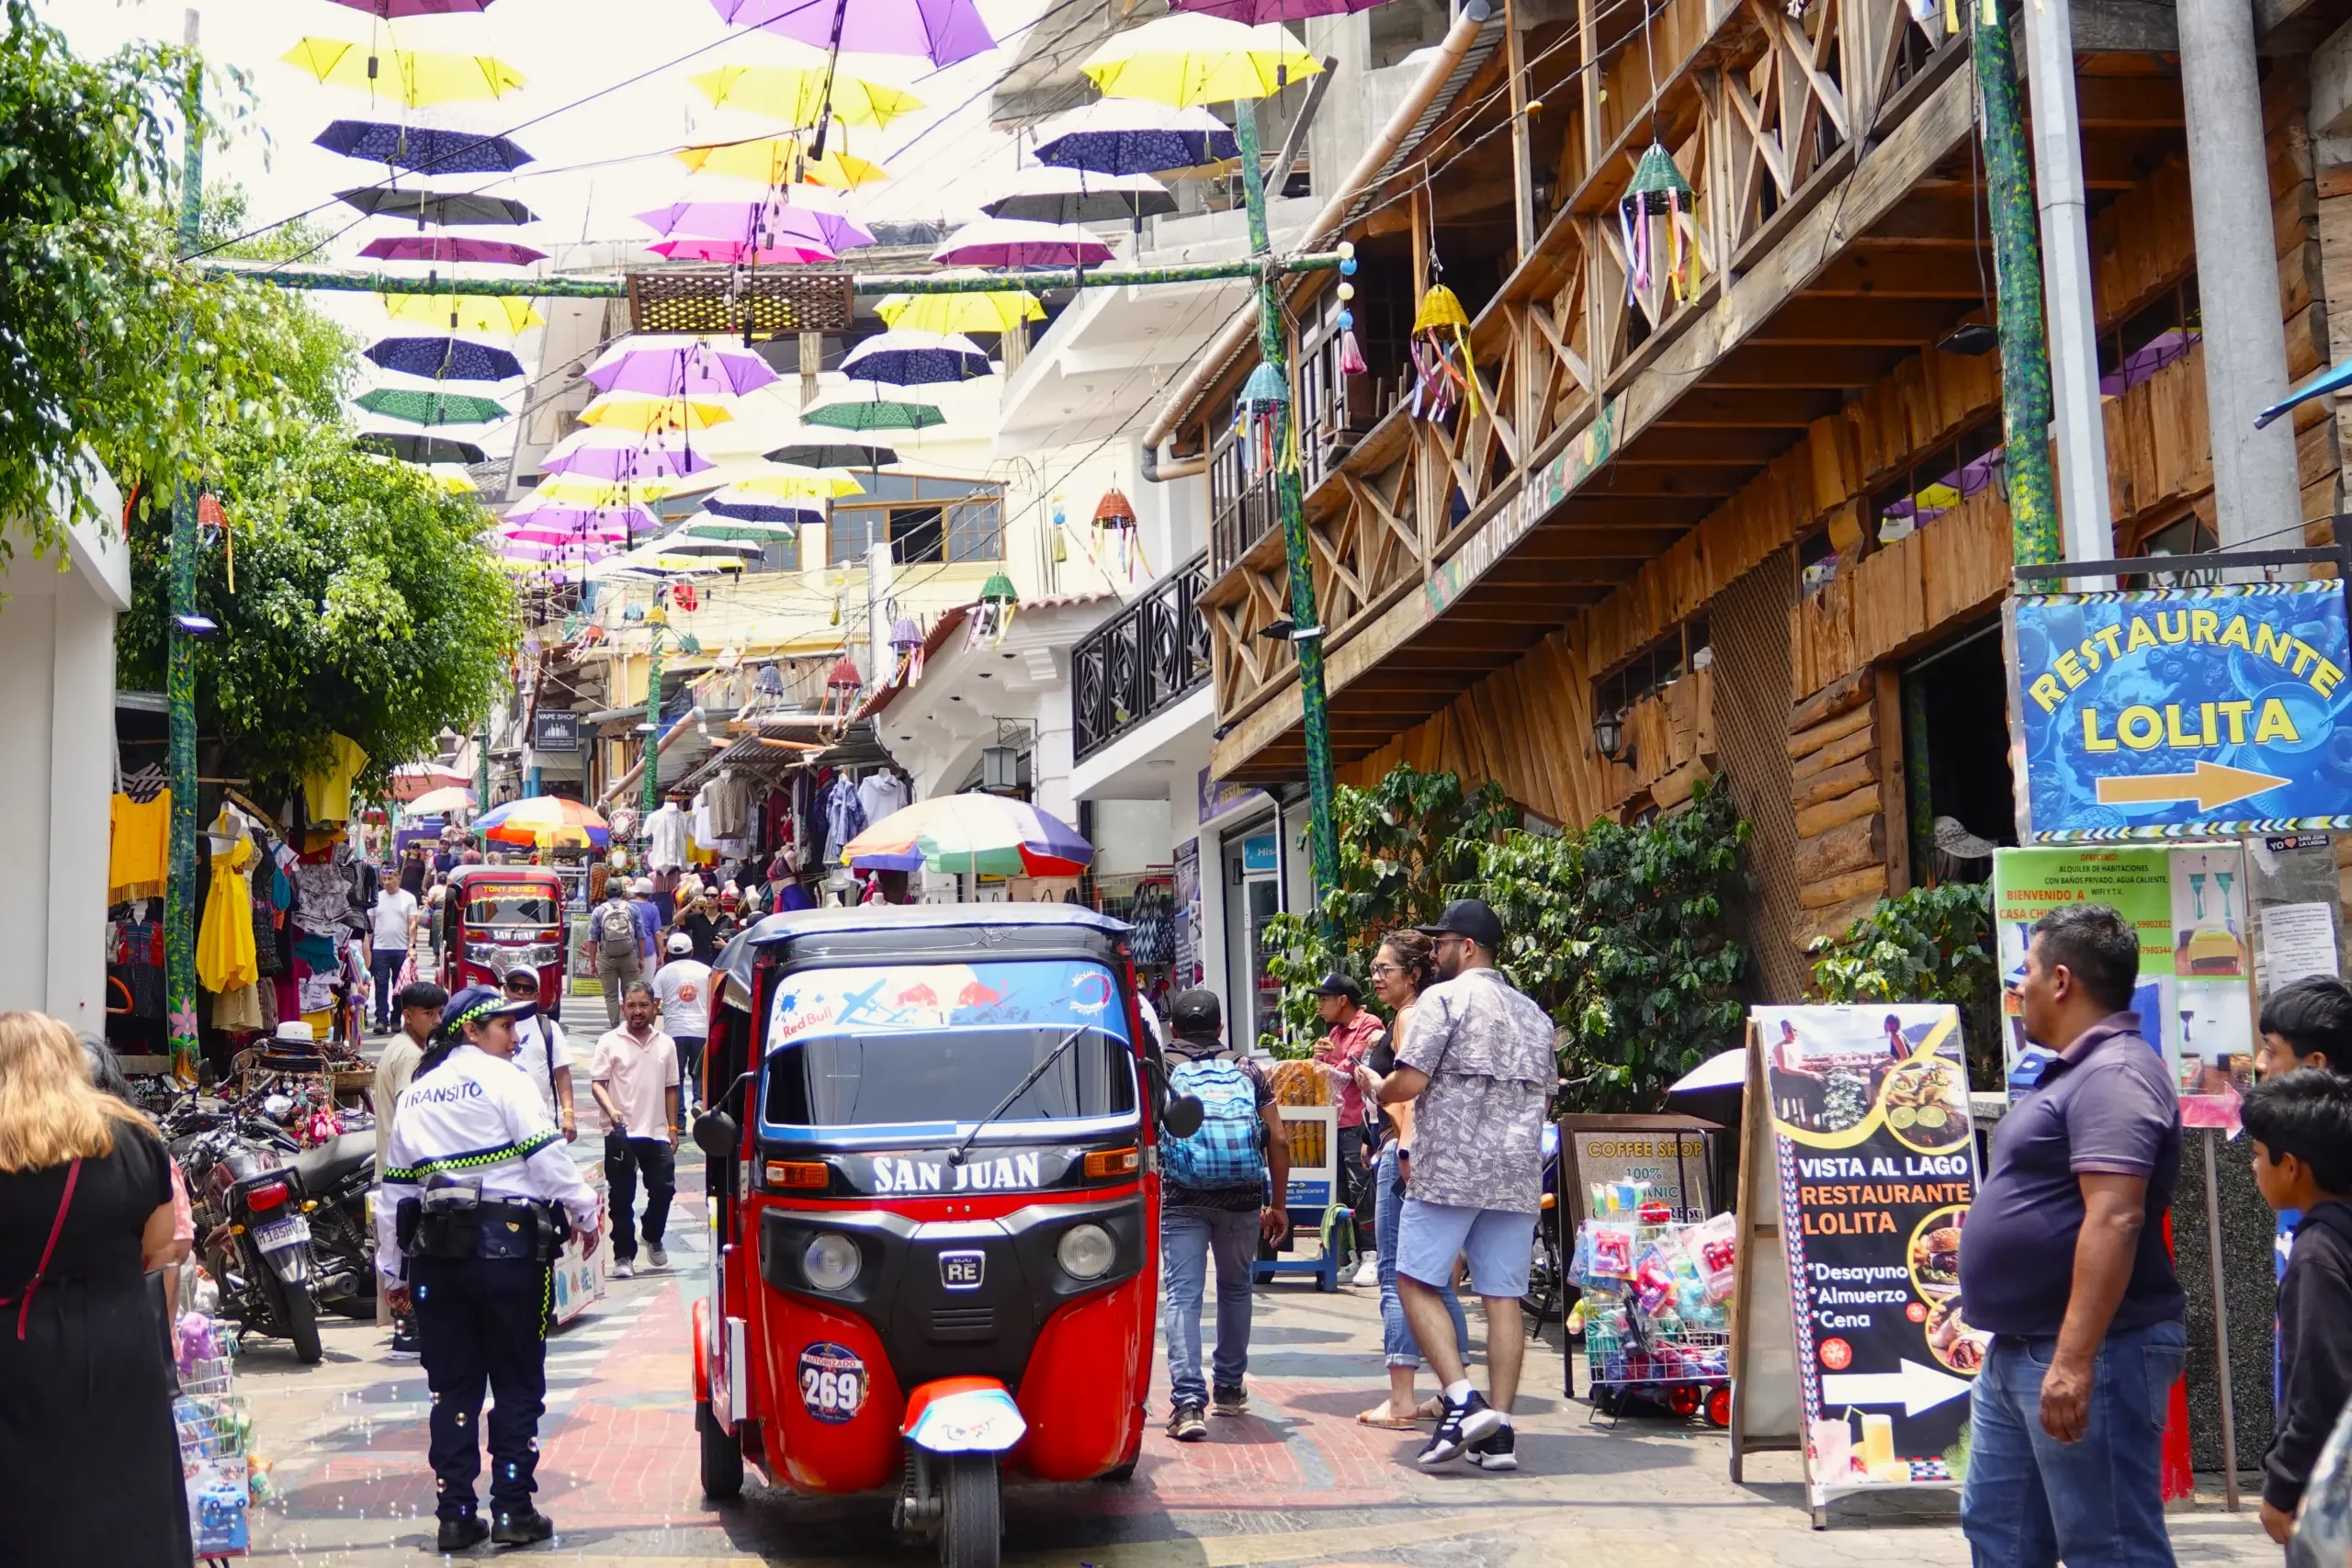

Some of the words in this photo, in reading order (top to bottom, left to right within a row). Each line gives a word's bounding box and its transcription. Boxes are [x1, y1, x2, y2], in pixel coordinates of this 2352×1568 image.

[1463, 525, 1487, 585] FLOR
[1492, 502, 1513, 559] DEL
[2027, 608, 2346, 714] RESTAURANTE
[2081, 698, 2301, 752] LOLITA
[2270, 841, 2285, 851] YO
[2080, 853, 2121, 862] OFRECEMOS:
[2059, 865, 2090, 874] ALQUILER
[2061, 875, 2084, 885] BAÑOS
[482, 886, 506, 894] TONY
[2007, 889, 2072, 901] BIENVENIDO
[2076, 889, 2085, 901] A
[1999, 908, 2027, 919] CASA
[493, 930, 511, 941] SAN
[513, 930, 536, 941] JUAN
[783, 1016, 806, 1039] Red
[807, 1006, 832, 1026] Bull
[404, 1081, 482, 1109] TRANSITO
[1588, 1142, 1654, 1158] COFFEE
[1657, 1142, 1704, 1158] SHOP
[874, 1156, 942, 1192] SAN
[953, 1151, 1040, 1190] JUAN
[1626, 1168, 1662, 1180] 100%
[1798, 1157, 1867, 1178] VISTA
[1871, 1158, 1899, 1177] AL
[1905, 1156, 1968, 1177] LAGO
[1801, 1183, 1972, 1205] RESTAURANTE
[1804, 1211, 1897, 1235] LOLITA
[948, 1263, 978, 1280] RE
[805, 1355, 856, 1368] AUTORIZADO
[805, 1368, 858, 1411] 269
